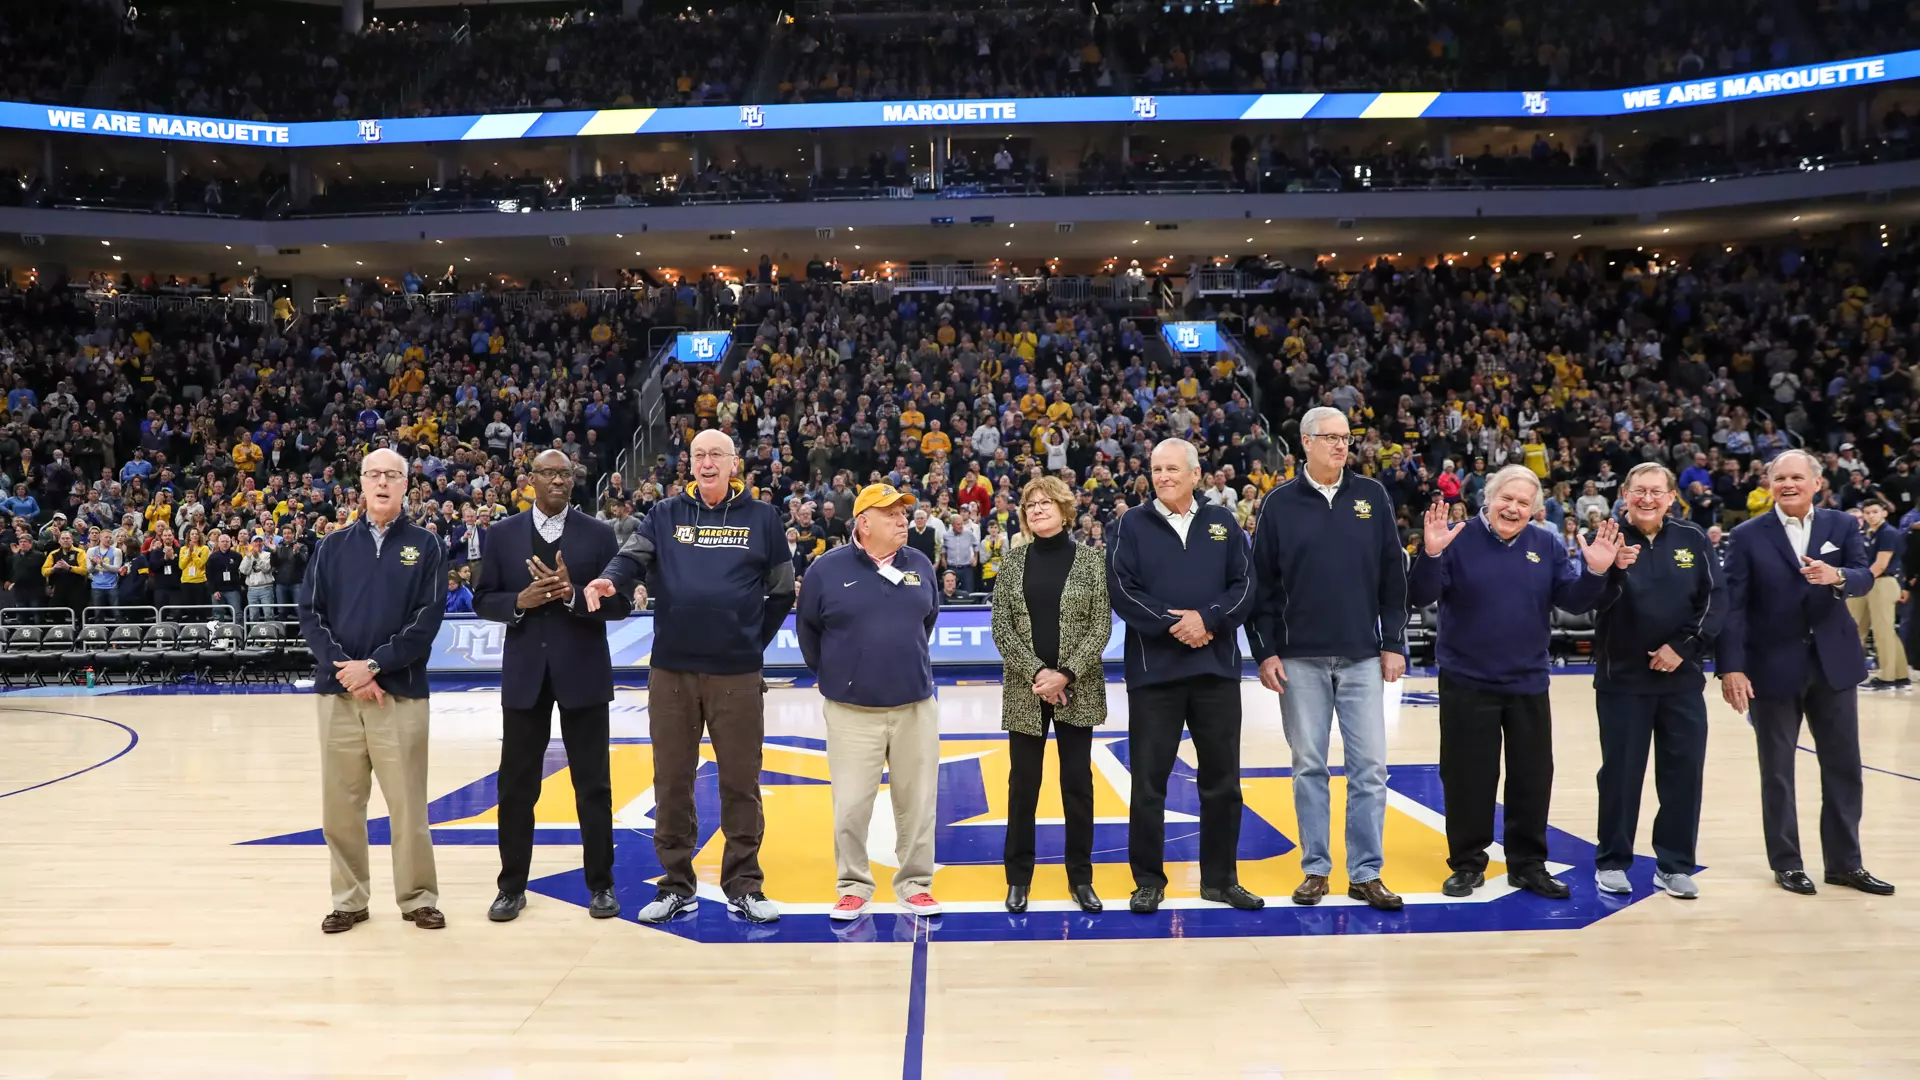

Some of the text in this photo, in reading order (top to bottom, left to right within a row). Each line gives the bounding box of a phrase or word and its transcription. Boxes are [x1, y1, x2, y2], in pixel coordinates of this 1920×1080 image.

[1623, 59, 1885, 109] WE ARE MARQUETTE
[883, 102, 1016, 122] MARQUETTE
[1132, 96, 1158, 119] MU
[1522, 91, 1549, 115] MU
[47, 109, 289, 143] WE ARE MARQUETTE
[740, 105, 765, 128] MU
[357, 120, 383, 142] MU
[818, 229, 831, 239] 117
[1059, 224, 1071, 233] 117
[690, 336, 716, 359] MU
[1176, 326, 1201, 349] MU
[673, 525, 696, 544] MU
[697, 536, 749, 546] UNIVERSITY
[698, 528, 750, 537] MARQUETTE
